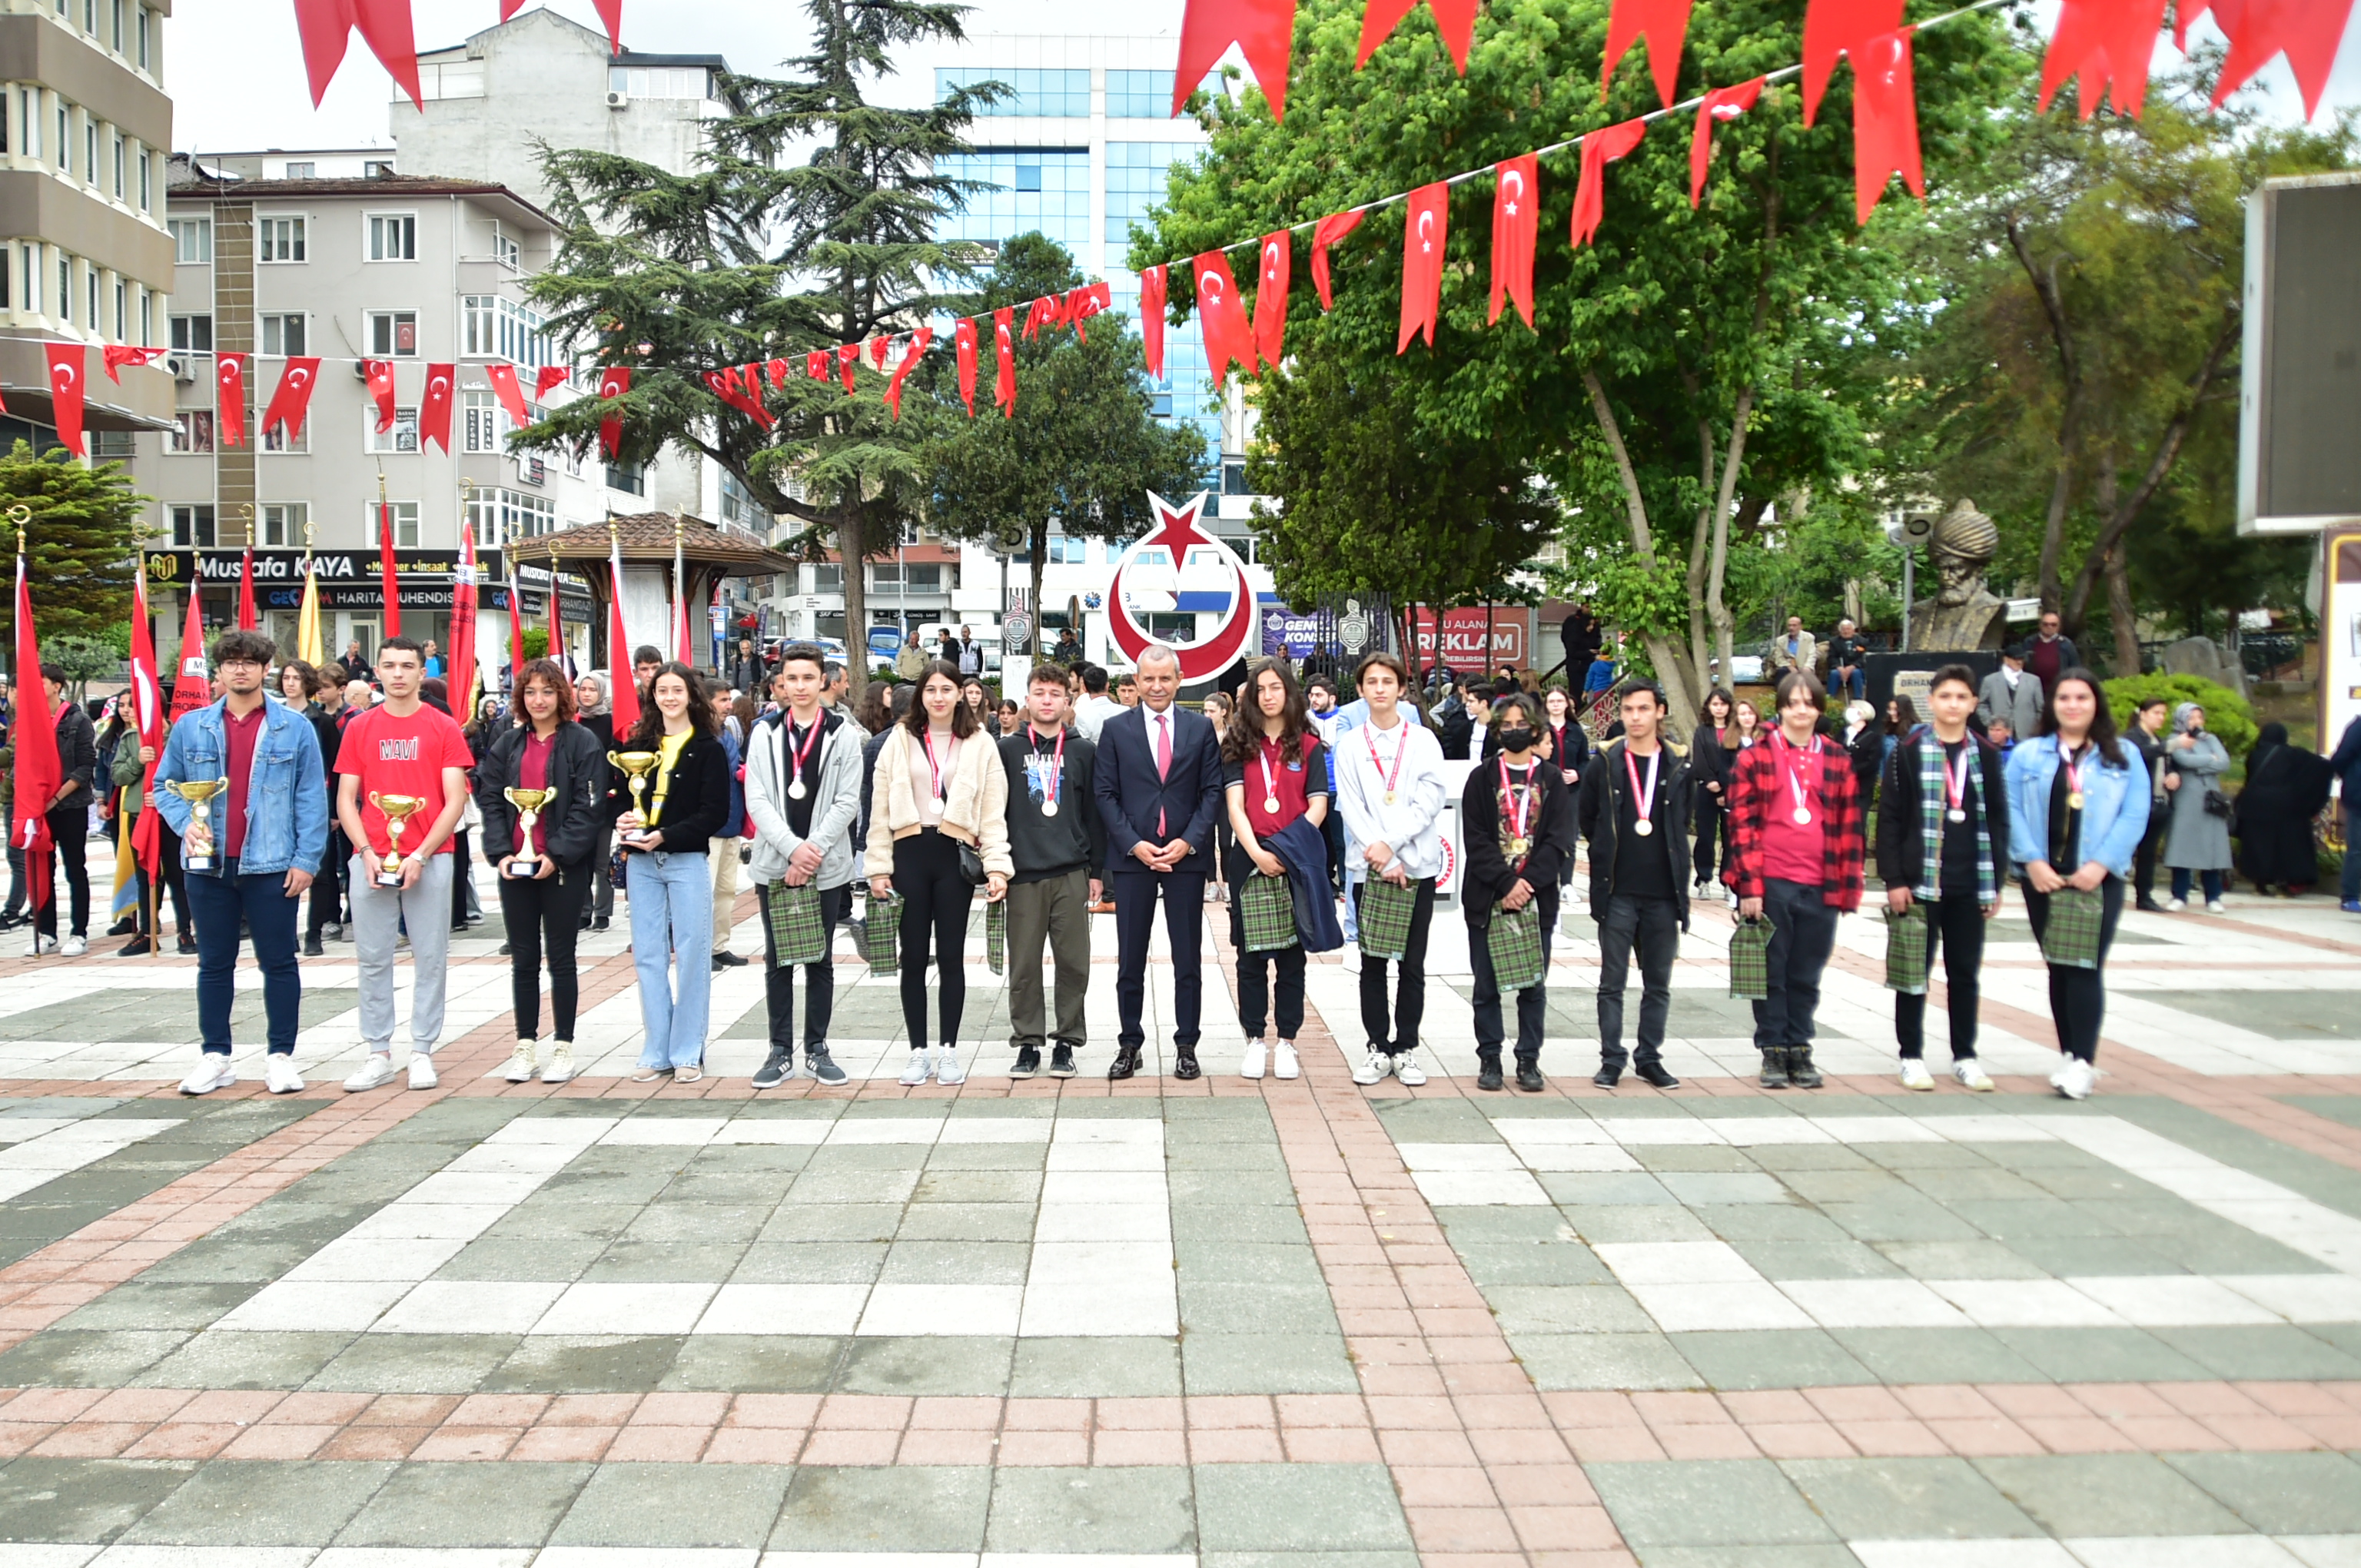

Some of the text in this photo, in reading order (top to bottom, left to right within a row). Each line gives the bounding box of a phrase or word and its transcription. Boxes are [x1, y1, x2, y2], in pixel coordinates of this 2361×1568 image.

[198, 556, 354, 577] Musafa KAYA
[1417, 633, 1513, 651] REKLAM
[379, 736, 417, 761] MAVİ
